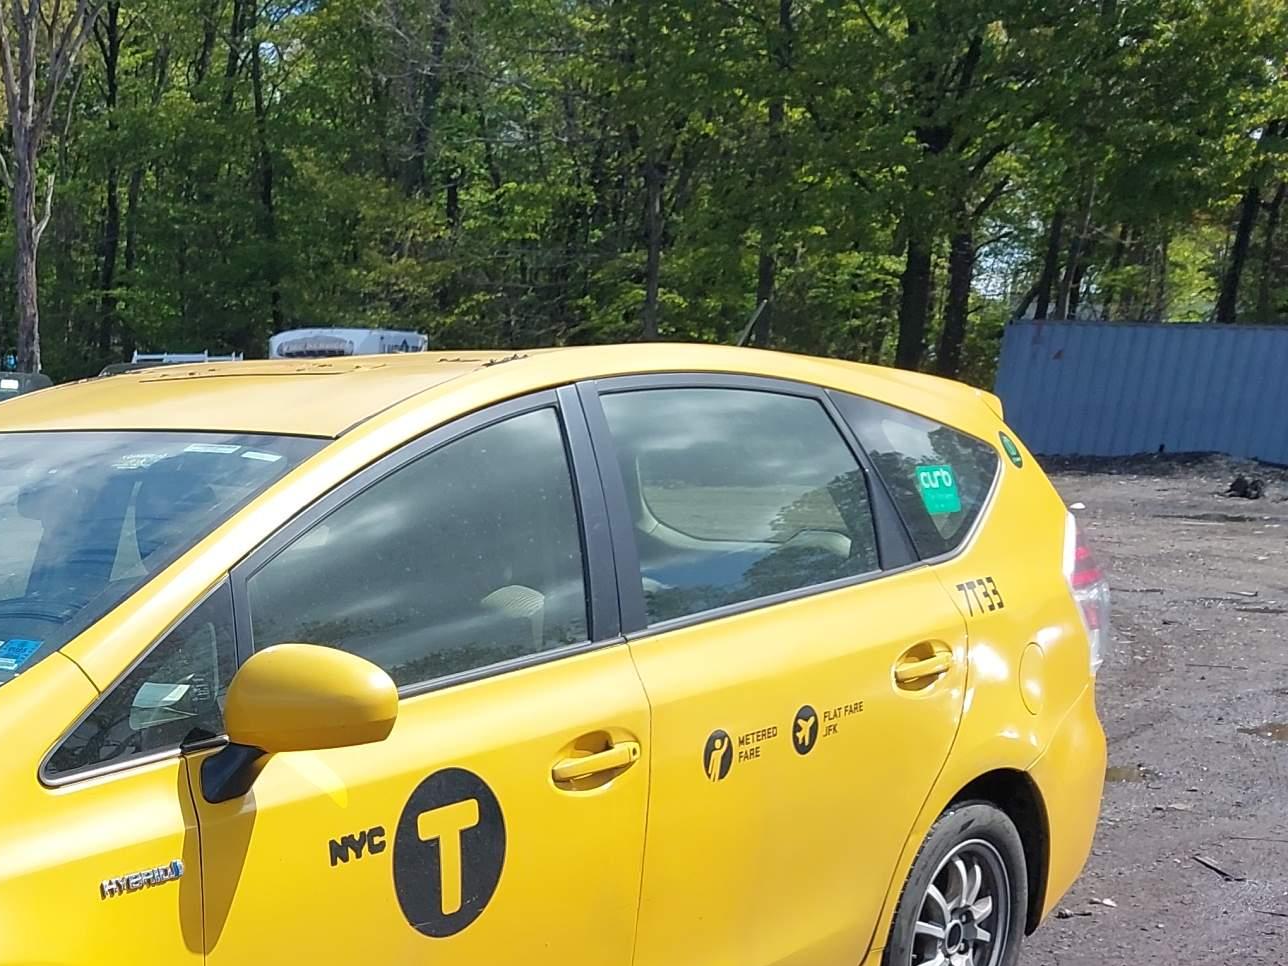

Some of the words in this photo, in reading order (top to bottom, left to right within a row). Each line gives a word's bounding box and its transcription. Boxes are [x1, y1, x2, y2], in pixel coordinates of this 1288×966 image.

[919, 468, 952, 489] curb
[823, 707, 842, 722] FLAT
[844, 701, 864, 716] FARE
[738, 726, 778, 747] METERED
[823, 724, 838, 738] JFK
[738, 746, 761, 763] FARE
[328, 825, 387, 867] NYC
[416, 797, 481, 916] T
[100, 866, 173, 900] HYBRID
